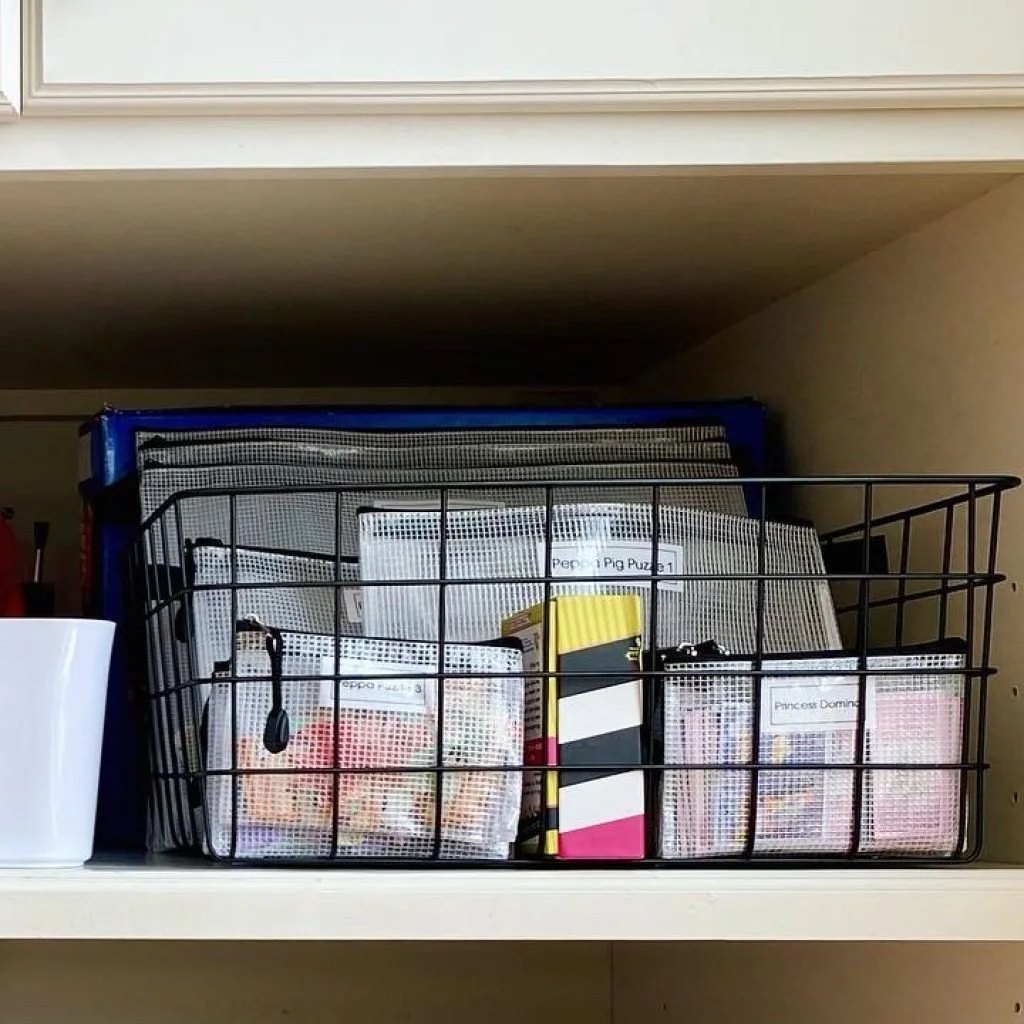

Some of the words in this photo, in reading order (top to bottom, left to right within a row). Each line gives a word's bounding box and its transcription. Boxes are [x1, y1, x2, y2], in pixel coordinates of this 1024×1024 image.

[552, 557, 600, 572] Pep
[604, 557, 624, 571] Pig
[667, 562, 674, 573] 1
[775, 701, 817, 711] Princess
